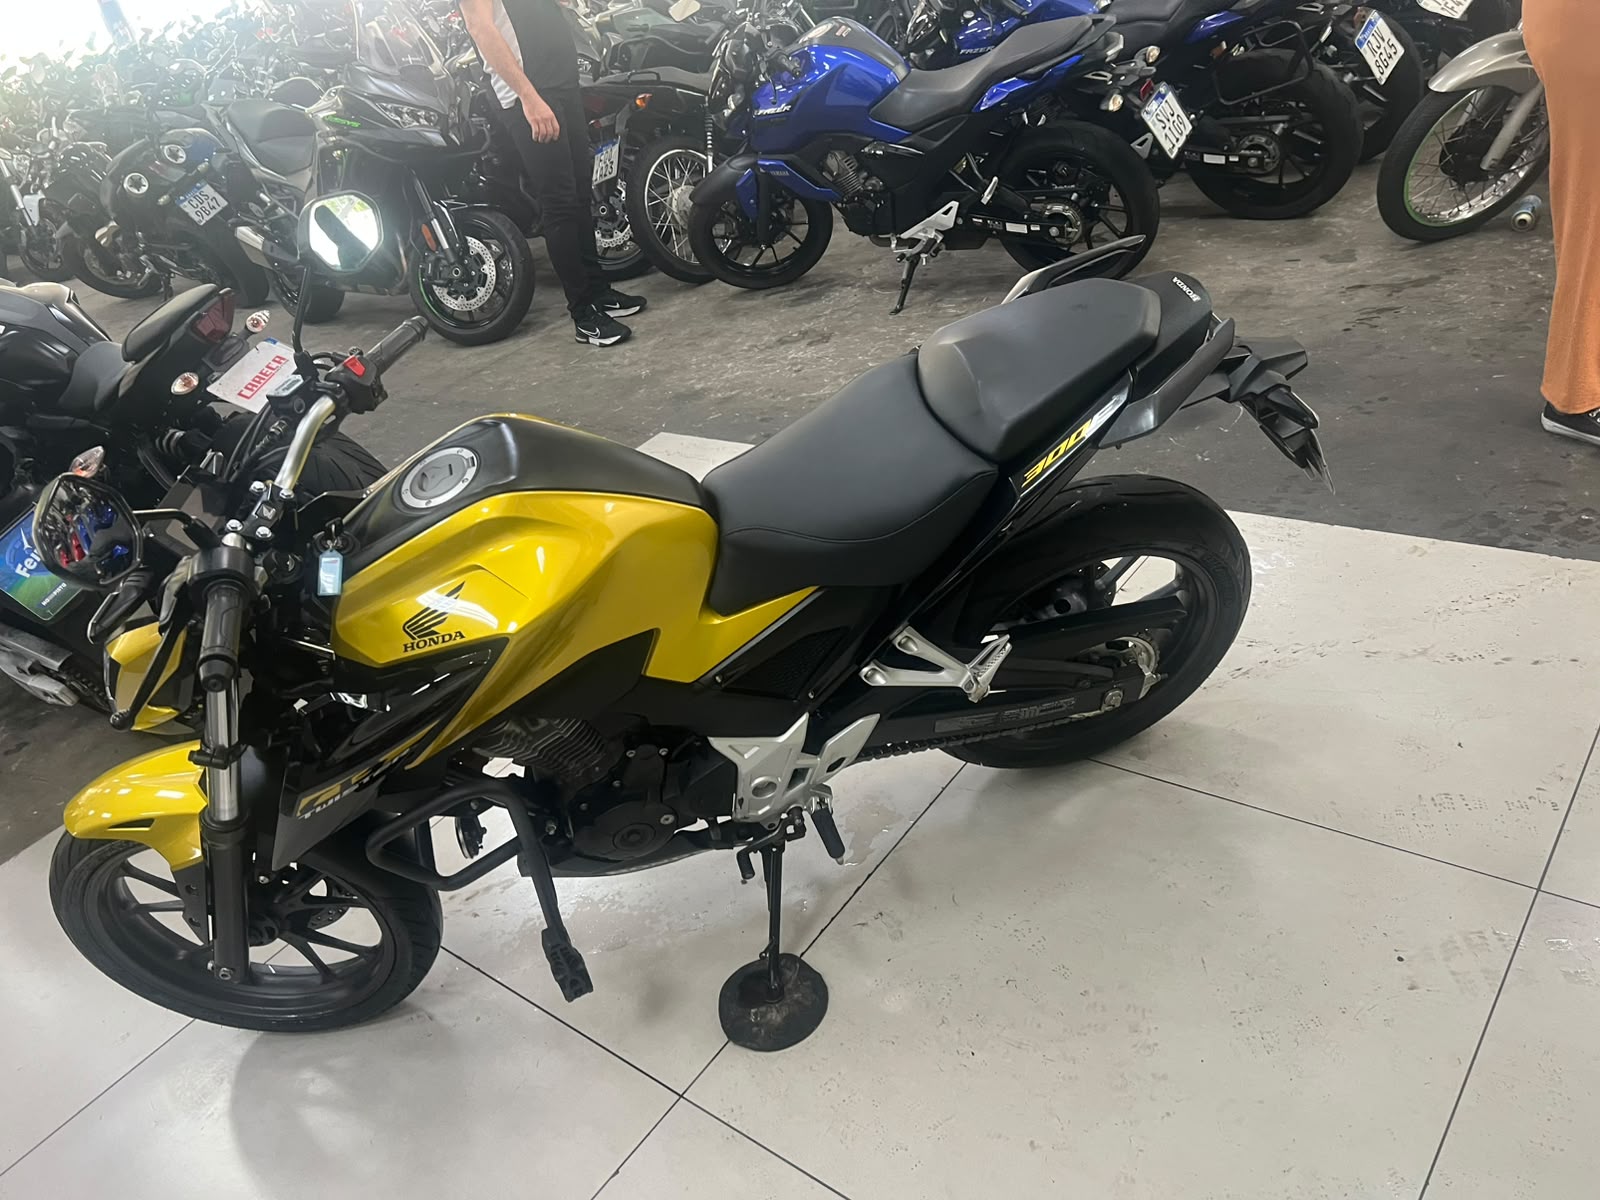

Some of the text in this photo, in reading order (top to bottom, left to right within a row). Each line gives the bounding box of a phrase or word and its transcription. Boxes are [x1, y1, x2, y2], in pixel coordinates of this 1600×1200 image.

[960, 45, 996, 55] FAZER
[1367, 26, 1385, 57] RJV
[1375, 38, 1398, 75] 8G45
[1155, 99, 1175, 130] SVJ
[187, 190, 210, 209] CDS
[195, 196, 221, 220] 9B47
[1172, 276, 1202, 302] HONDA
[402, 630, 466, 653] HONDA
